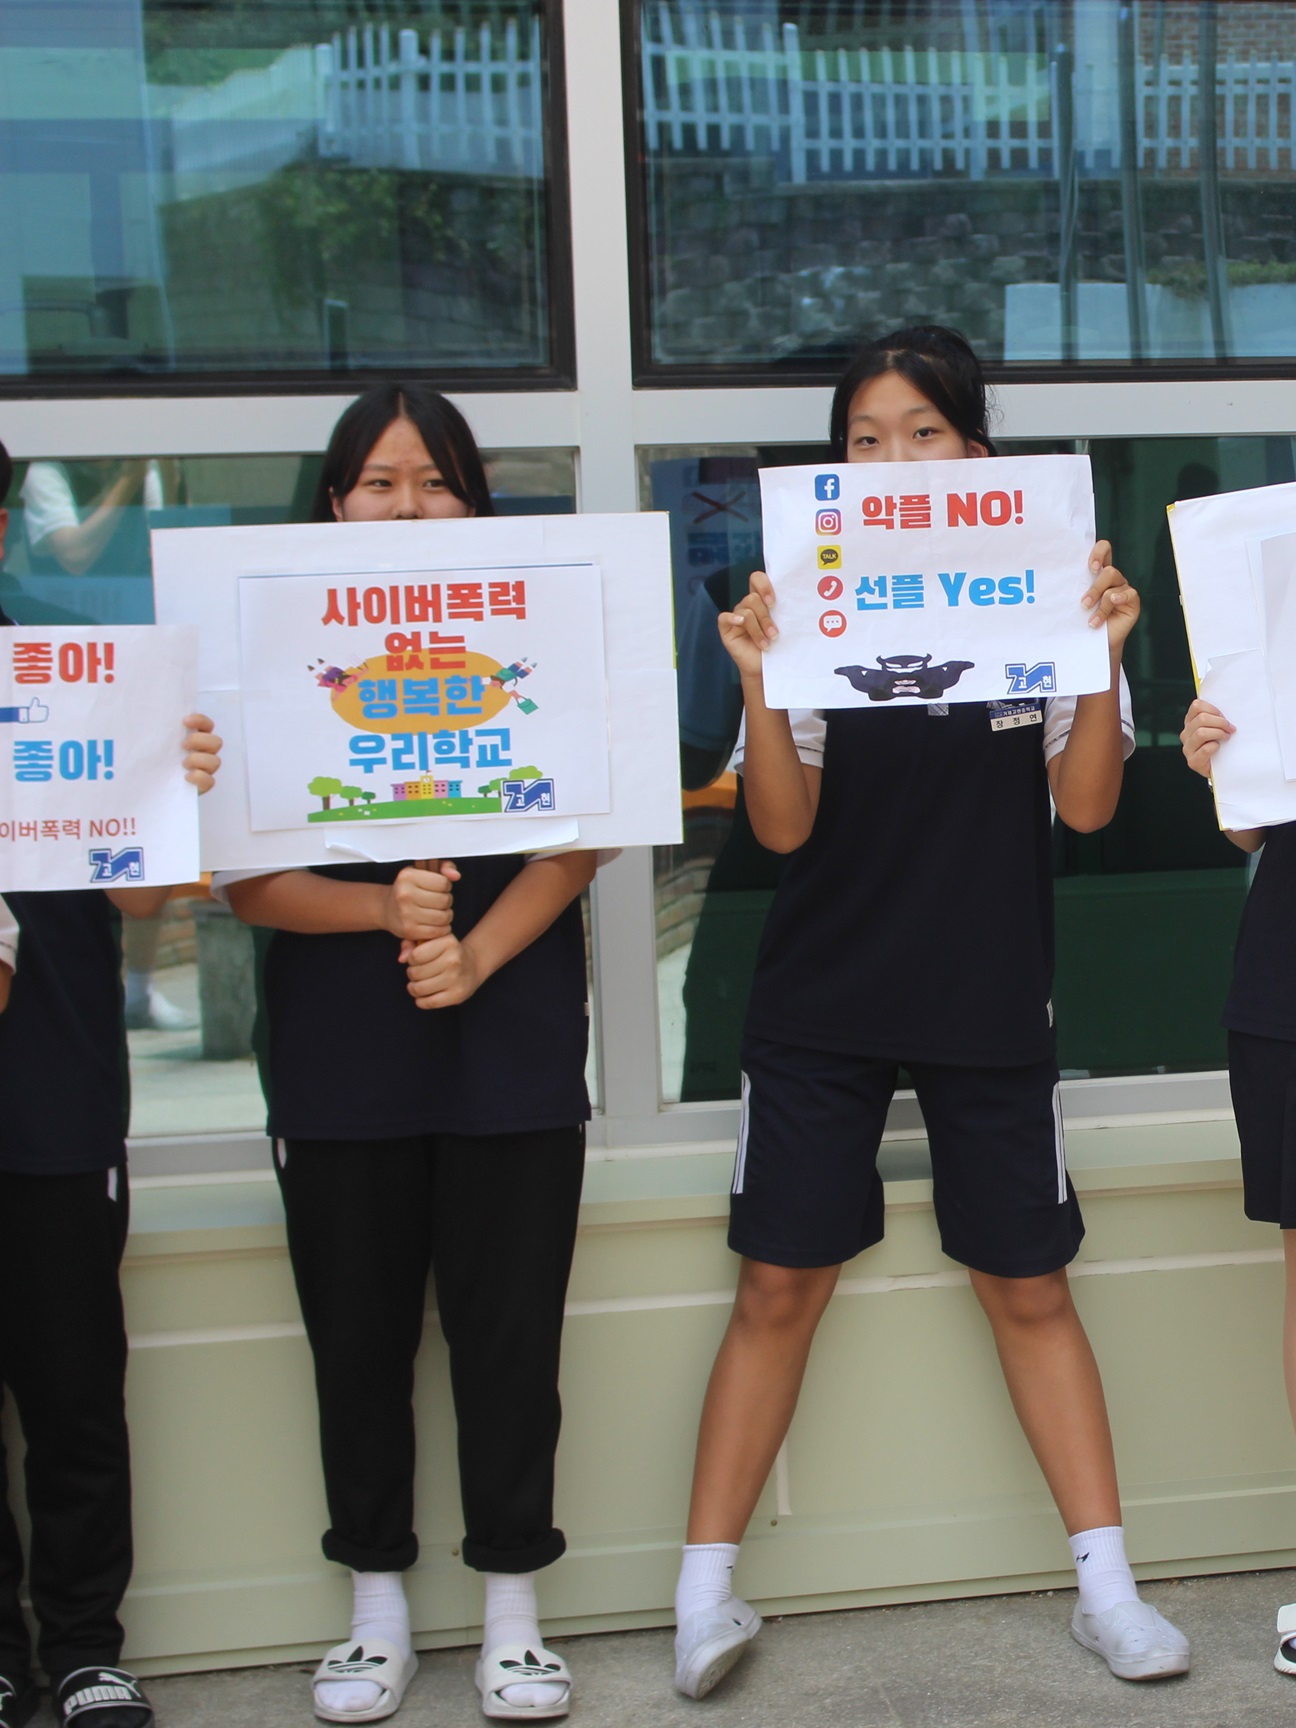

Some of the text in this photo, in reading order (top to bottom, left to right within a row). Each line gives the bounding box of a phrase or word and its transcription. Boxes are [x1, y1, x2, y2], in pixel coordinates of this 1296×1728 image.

[862, 490, 1024, 530] 악플 NO!
[822, 553, 837, 561] TALK
[321, 580, 527, 626] 사이버폭력
[855, 569, 1036, 611] 선플 Yes!
[13, 642, 115, 684] 좋아!
[384, 630, 466, 672] 없는
[358, 674, 485, 719] 행복한
[13, 739, 114, 782] 좋아!
[348, 727, 512, 774] 우리학교
[89, 817, 136, 837] NO!!
[63, 1685, 132, 1716] PUMA
